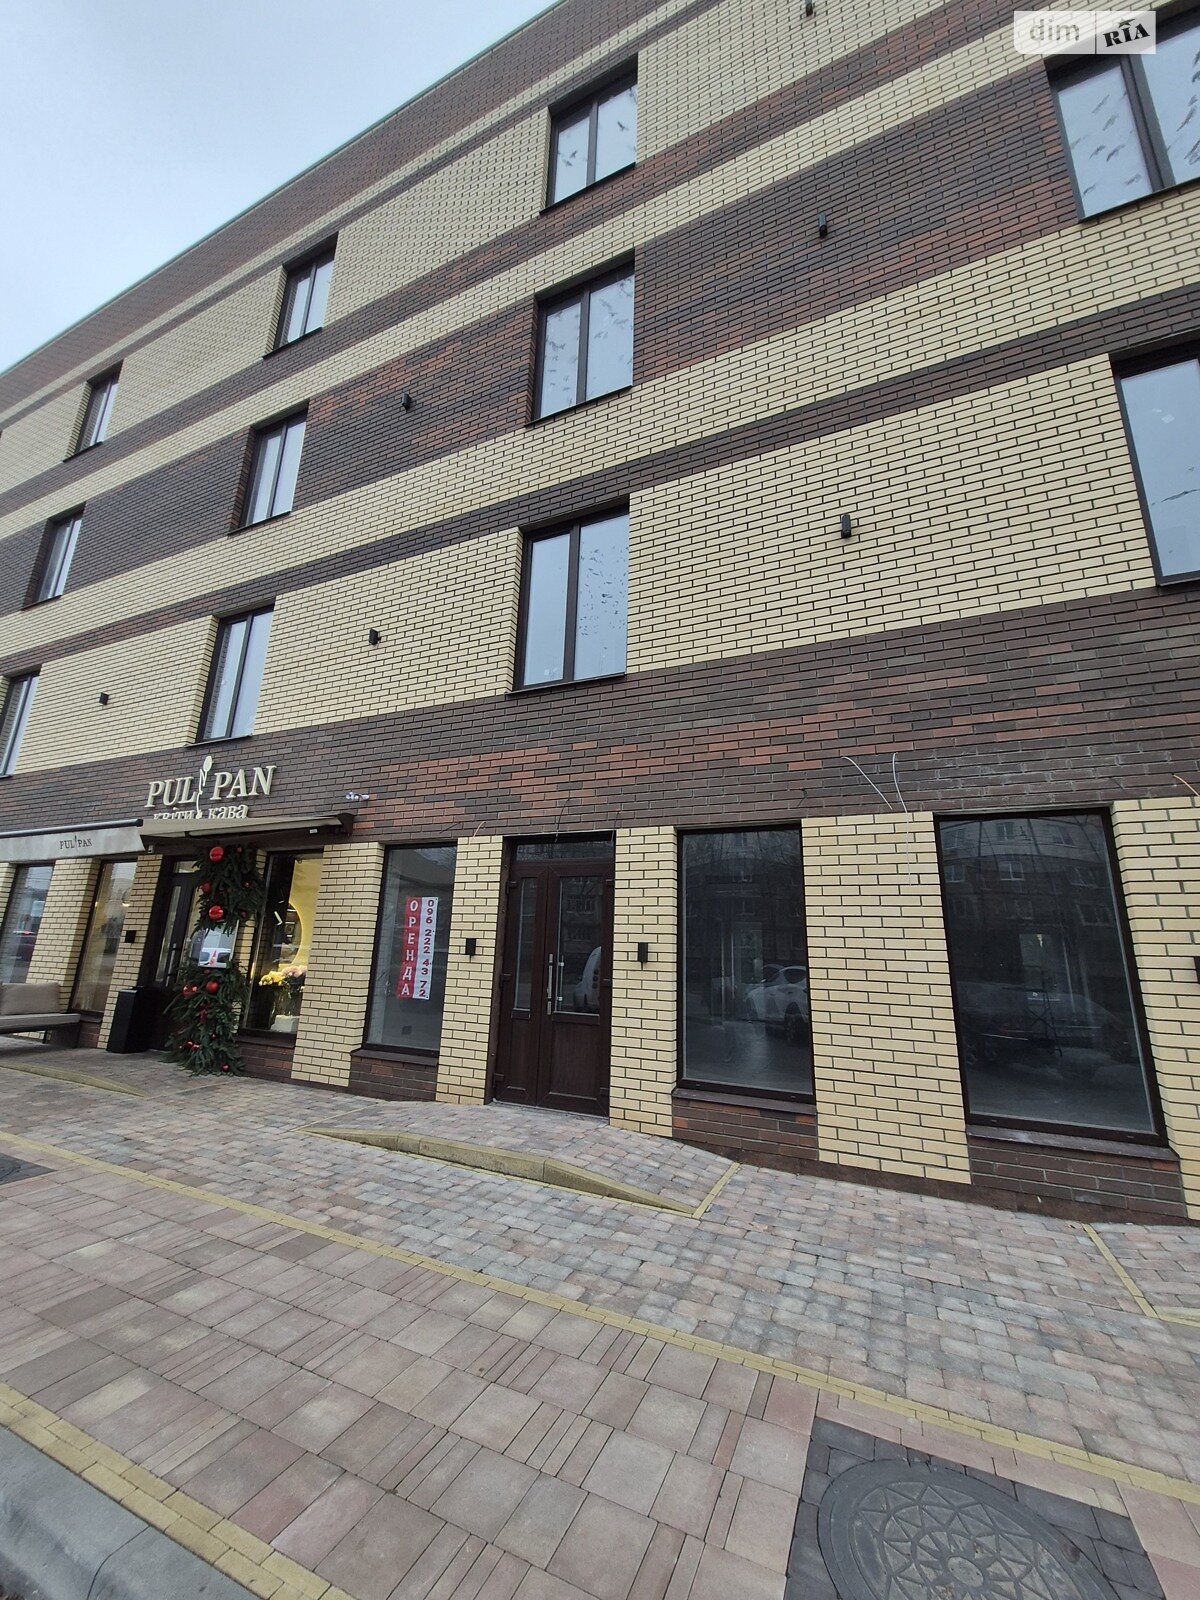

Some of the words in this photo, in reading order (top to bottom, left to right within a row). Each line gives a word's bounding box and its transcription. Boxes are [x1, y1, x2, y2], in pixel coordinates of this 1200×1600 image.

[209, 765, 277, 800] PAN
[208, 804, 249, 820] кава
[401, 900, 419, 996] ОРЕНДА
